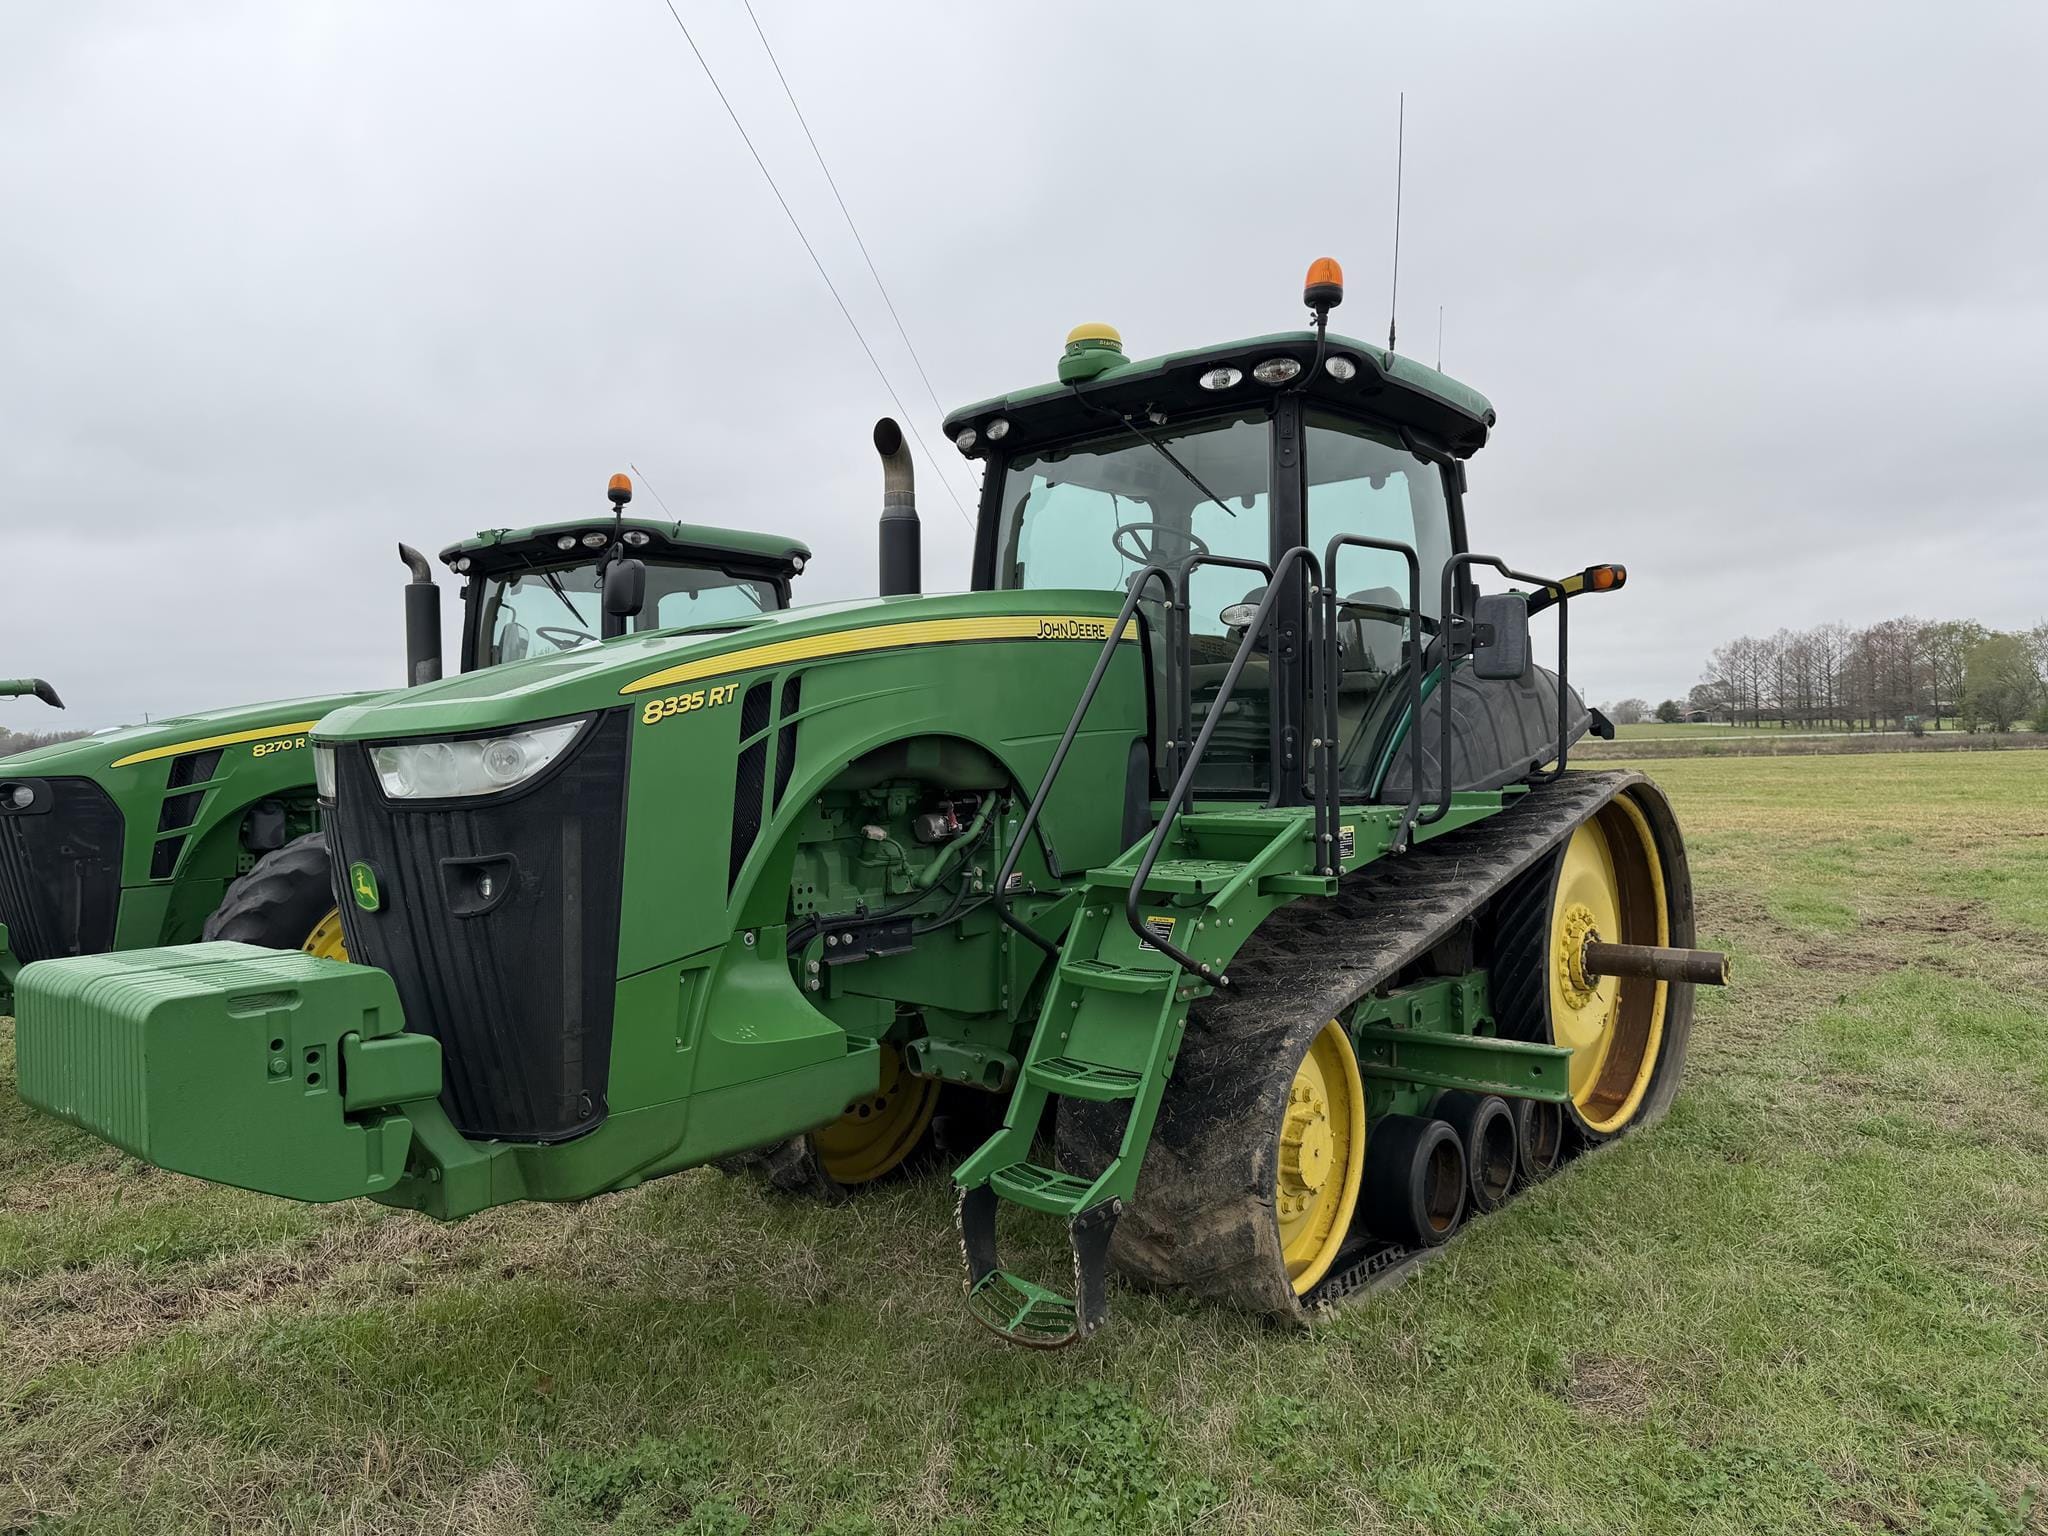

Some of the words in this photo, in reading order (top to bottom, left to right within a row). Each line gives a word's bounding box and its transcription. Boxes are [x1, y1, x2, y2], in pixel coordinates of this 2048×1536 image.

[1037, 619, 1068, 637] JOHN
[1070, 620, 1106, 637] DEERE
[642, 690, 706, 725] 8335
[708, 682, 740, 708] RT
[252, 739, 293, 757] 8270
[295, 737, 306, 749] R
